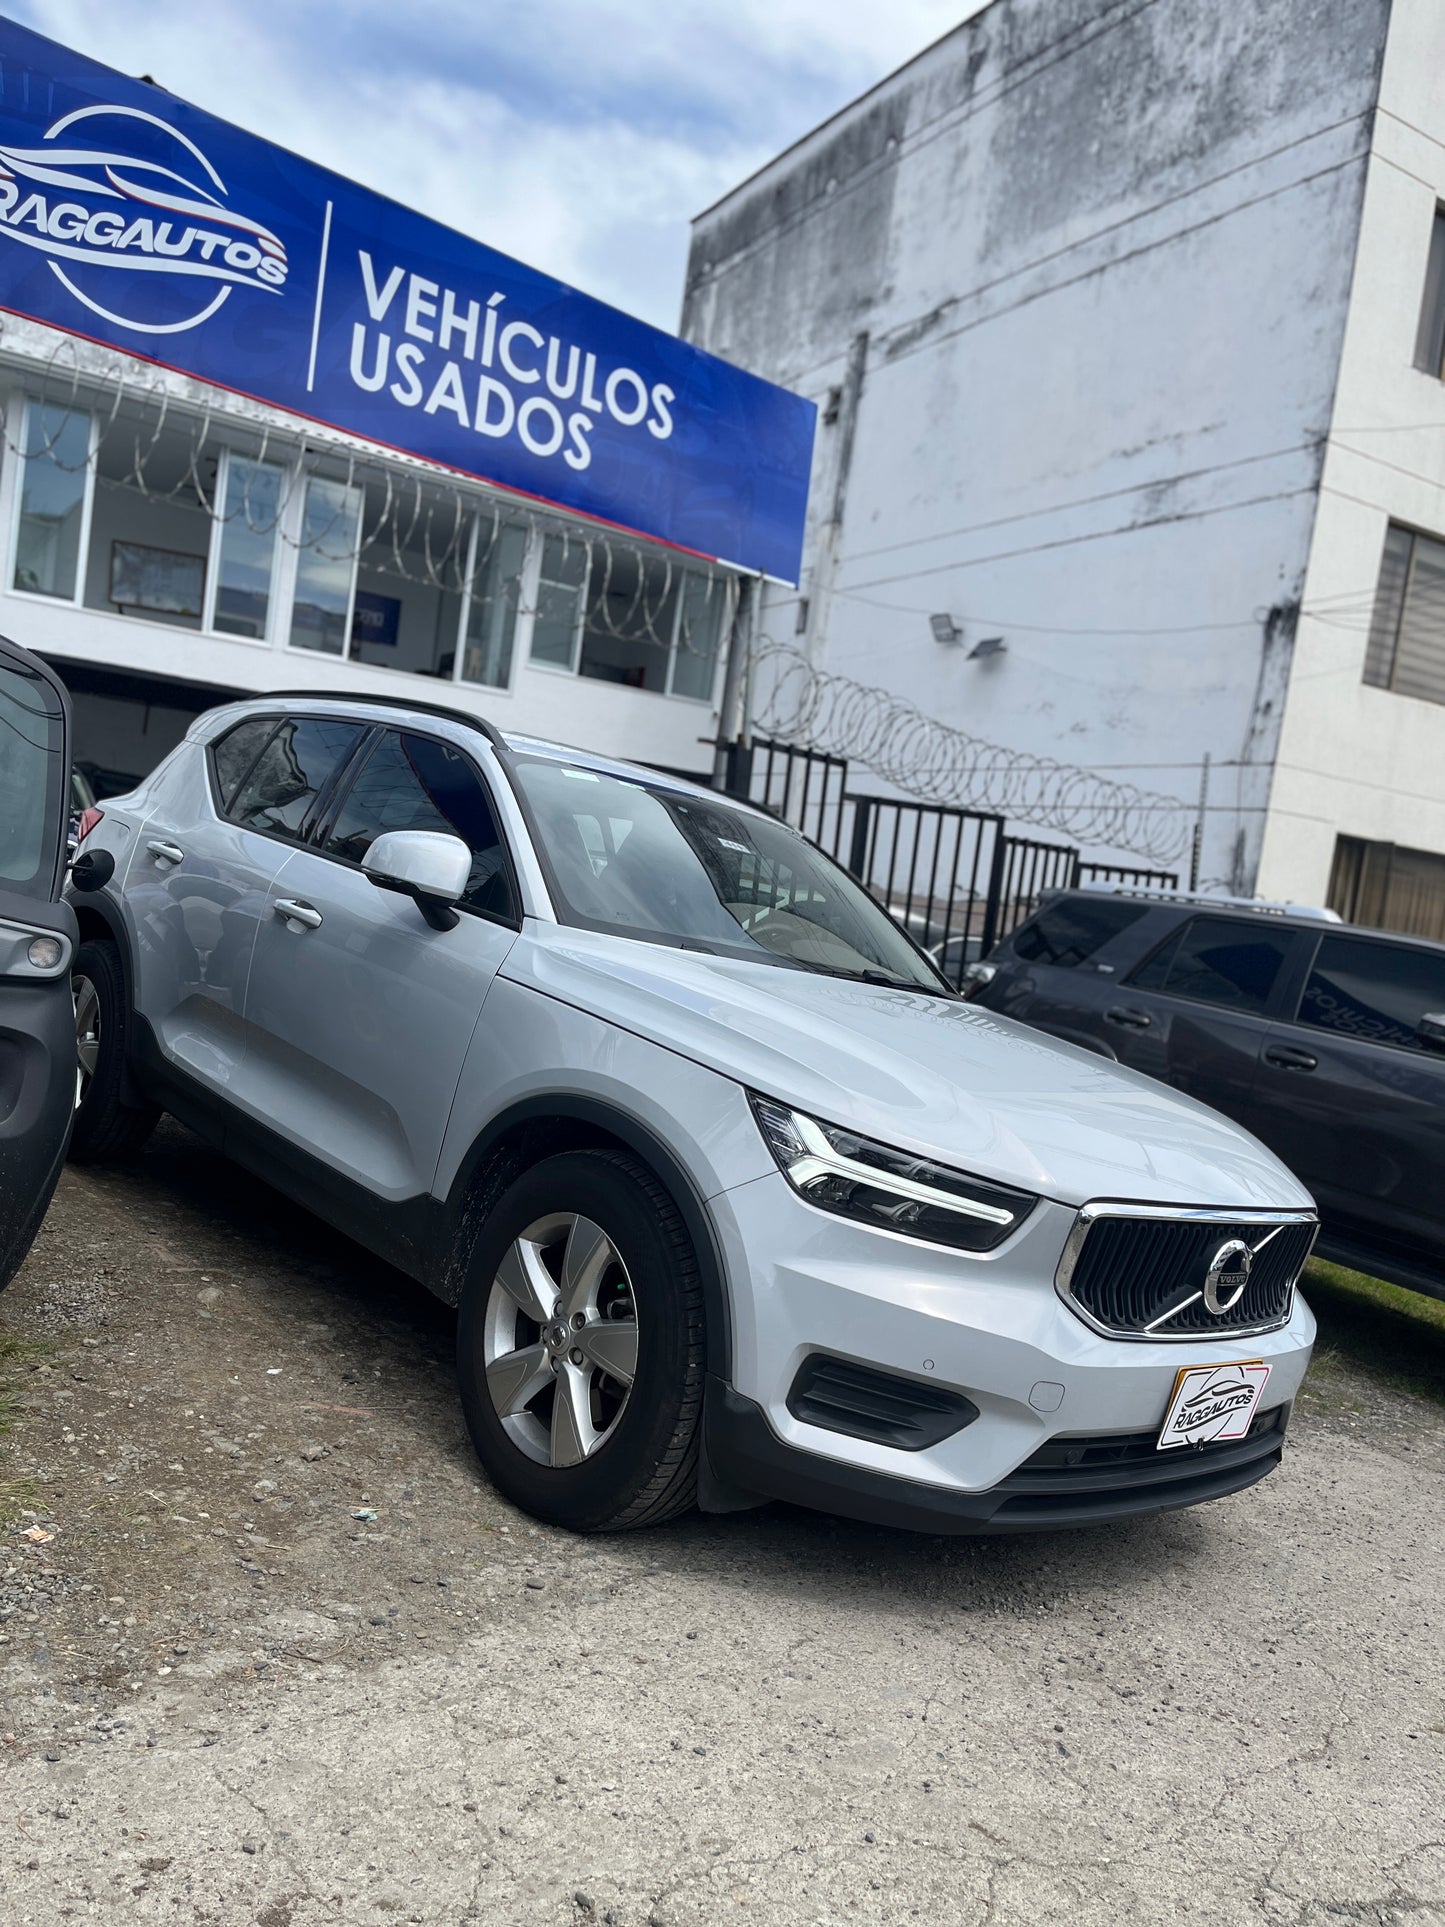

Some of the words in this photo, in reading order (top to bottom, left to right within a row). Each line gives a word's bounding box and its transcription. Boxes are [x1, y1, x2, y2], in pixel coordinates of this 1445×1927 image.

[0, 178, 289, 285] RAGGAUTOS
[350, 322, 594, 471] USADOS
[358, 249, 676, 440] VEHÍCULOS
[1173, 1394, 1253, 1429] RAGGAUTOS
